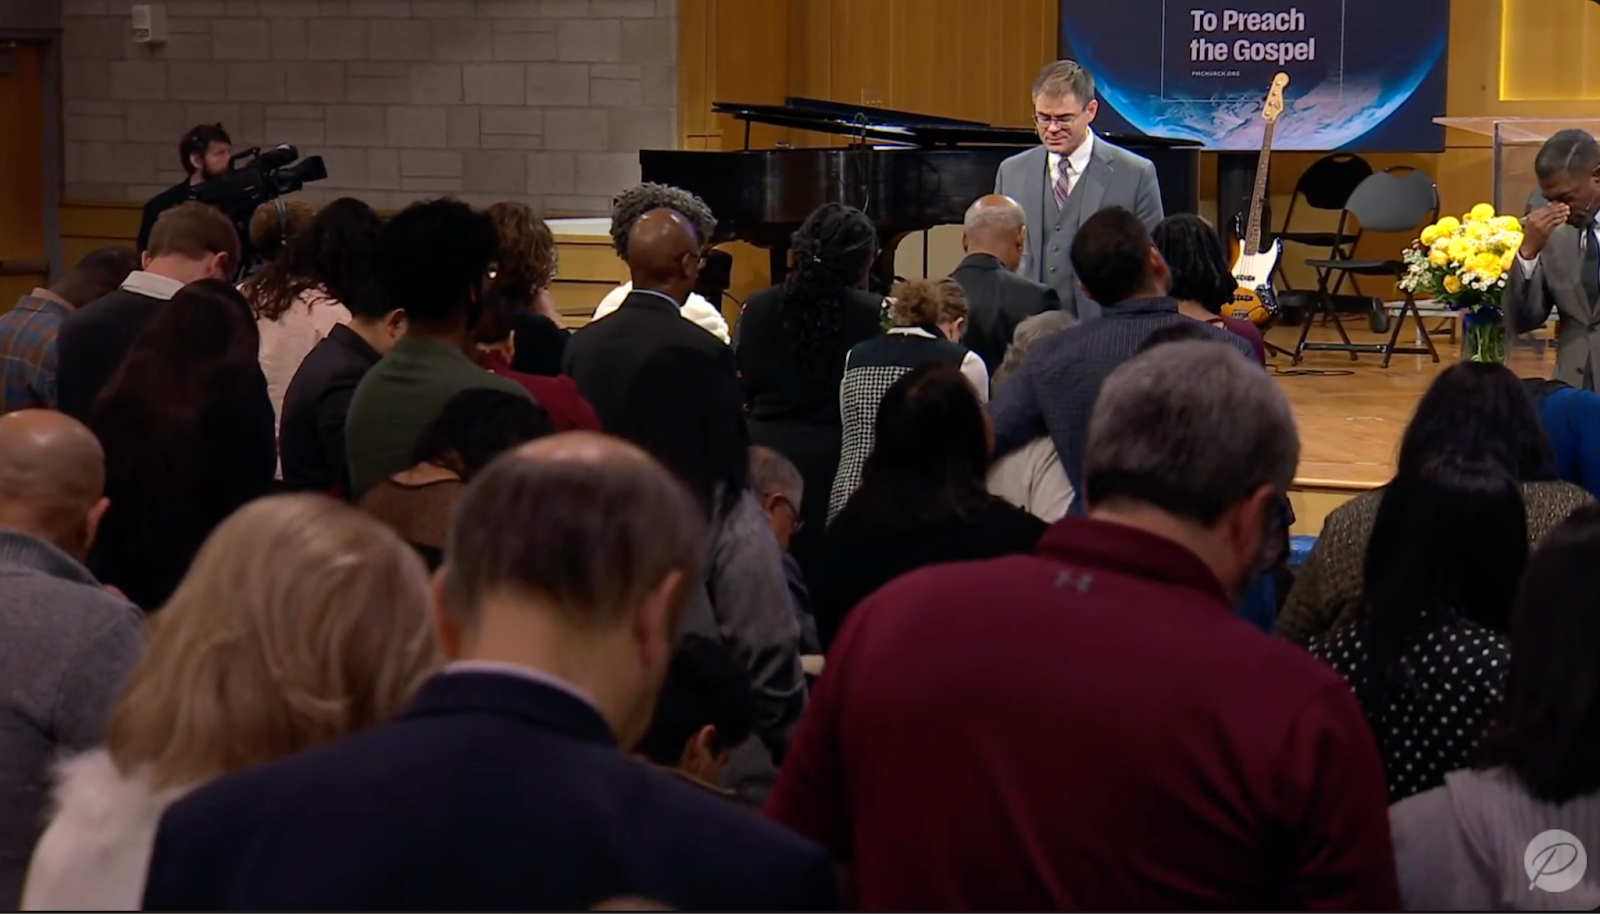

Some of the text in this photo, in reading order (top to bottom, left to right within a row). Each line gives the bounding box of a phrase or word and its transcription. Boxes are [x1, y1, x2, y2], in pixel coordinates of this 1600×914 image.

[1190, 8, 1305, 31] To Preach
[1190, 38, 1315, 65] the Gospel
